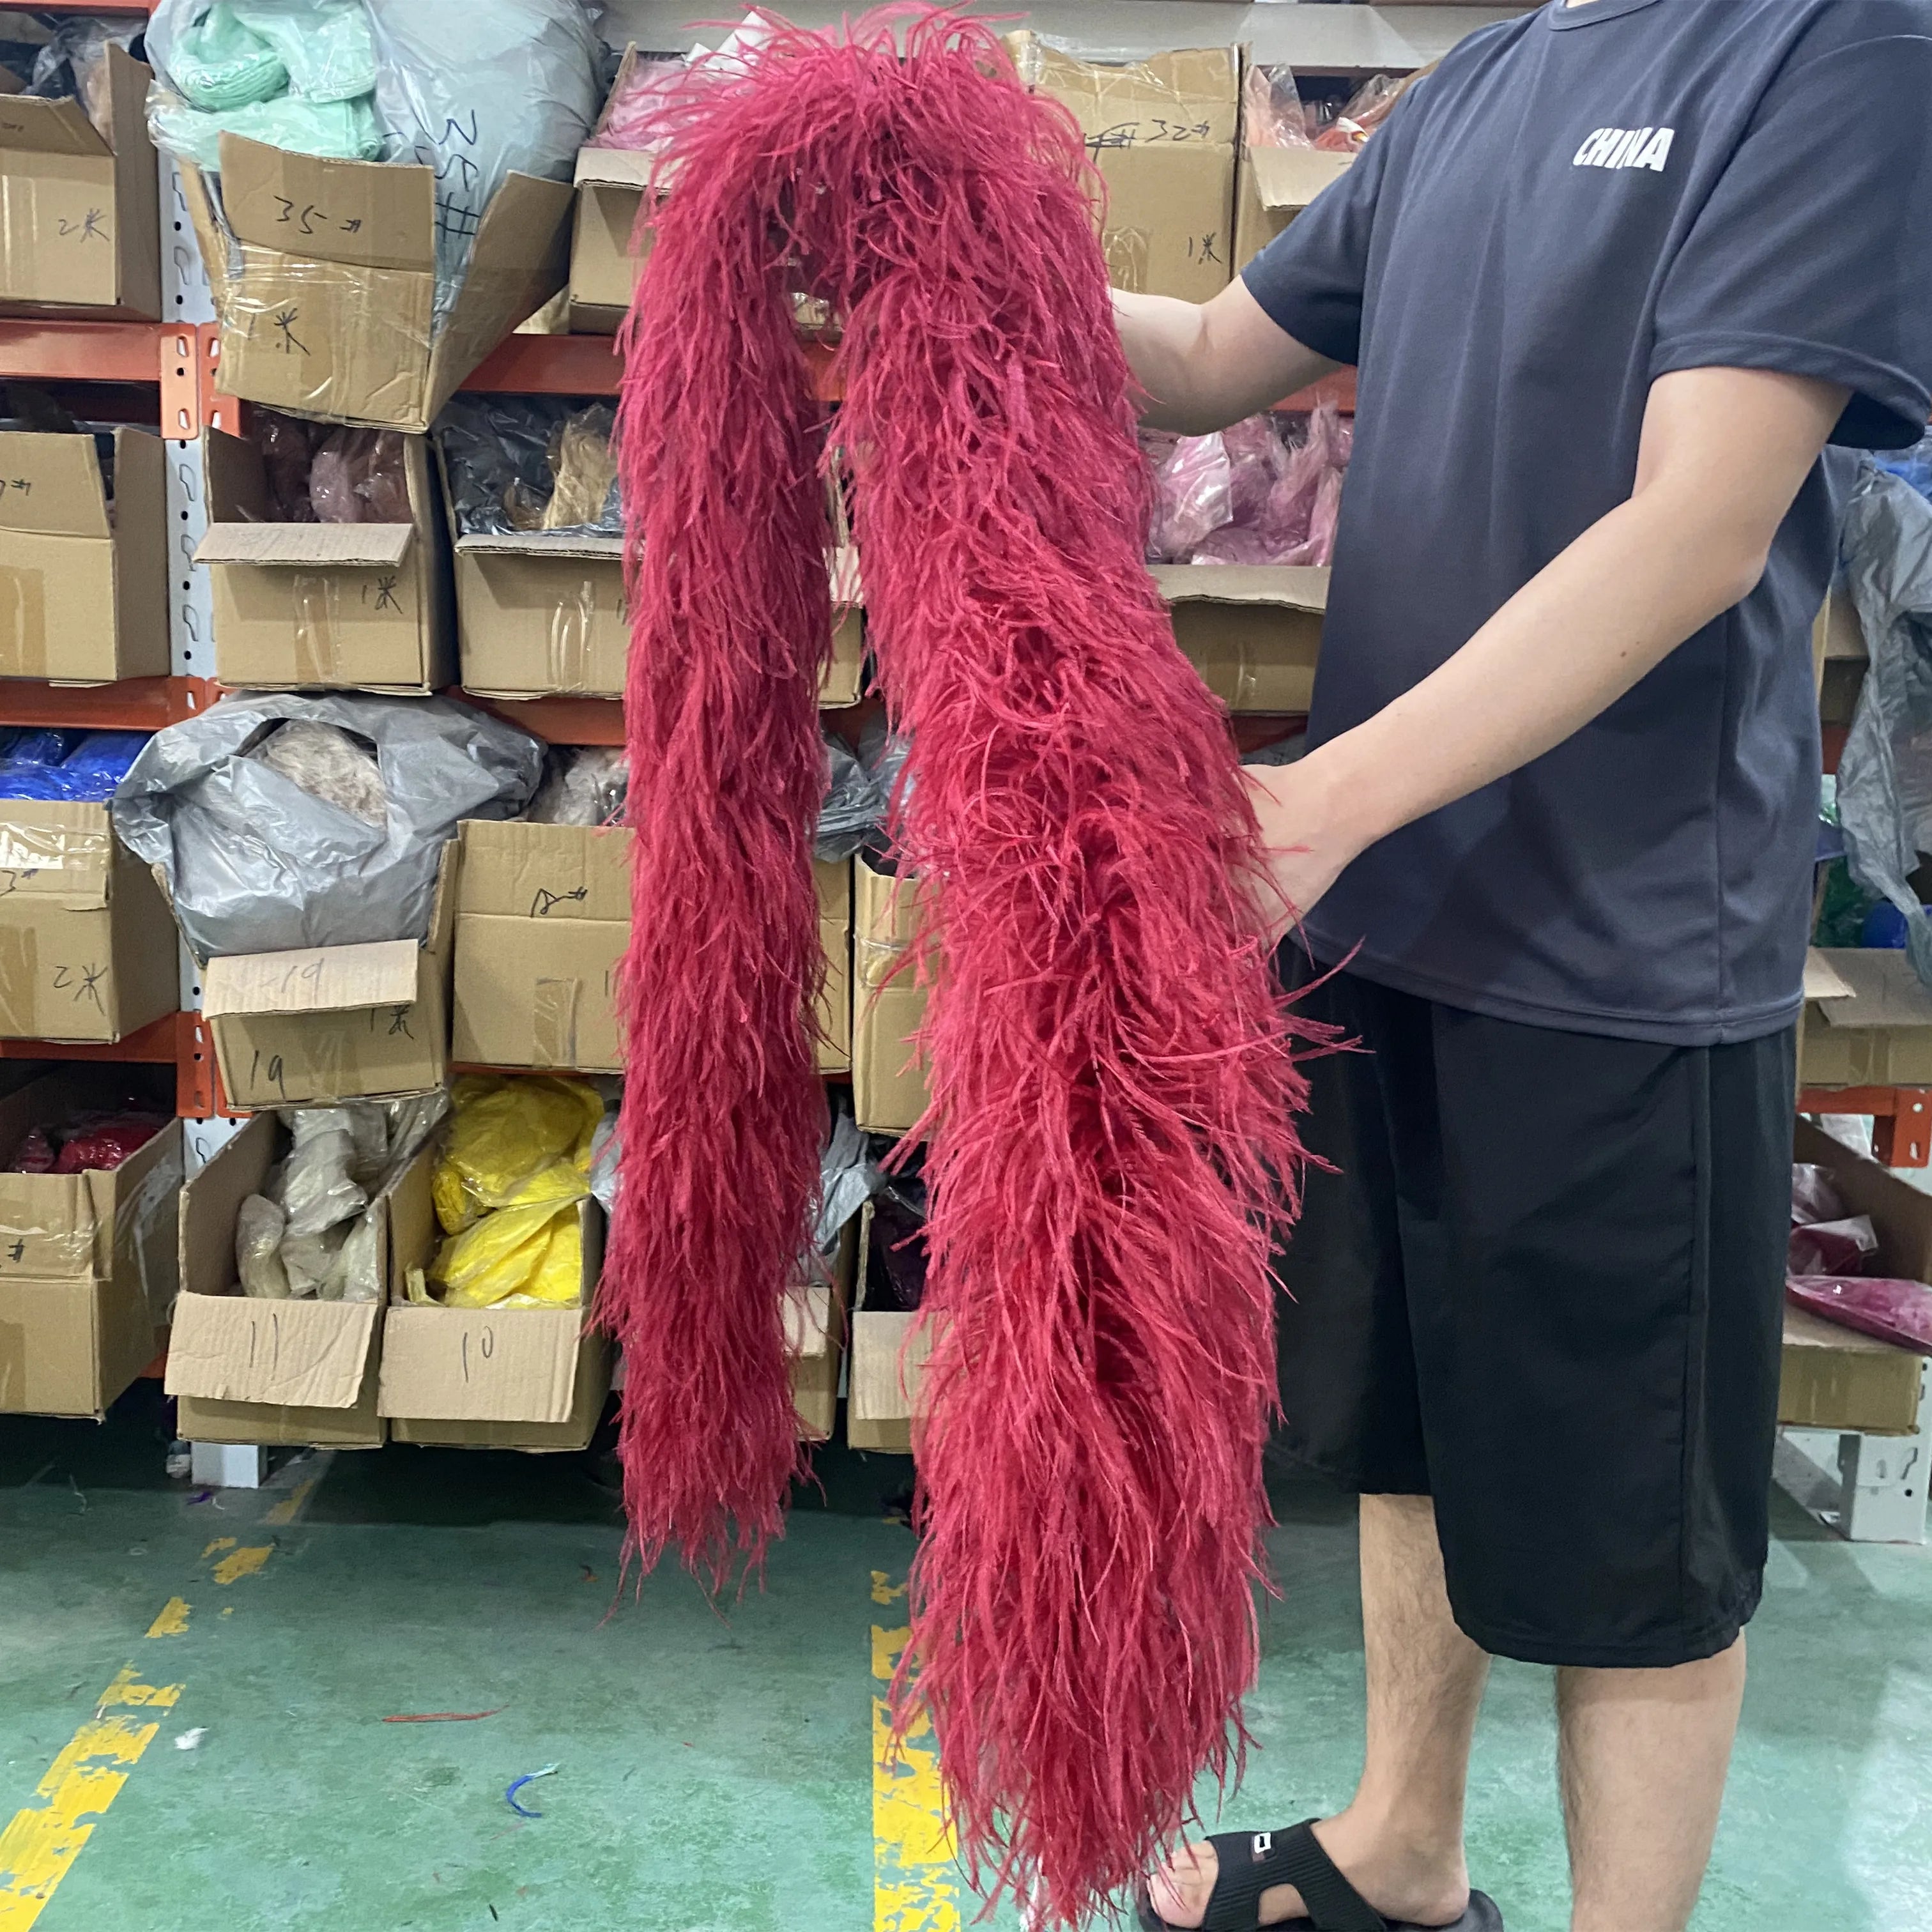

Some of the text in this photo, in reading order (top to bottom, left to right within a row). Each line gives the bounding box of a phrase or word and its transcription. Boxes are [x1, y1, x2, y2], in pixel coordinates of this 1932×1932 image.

[1573, 127, 1675, 172] CHINA
[250, 1050, 293, 1100] 19
[249, 1313, 279, 1381] 11
[461, 1325, 494, 1383] 10
